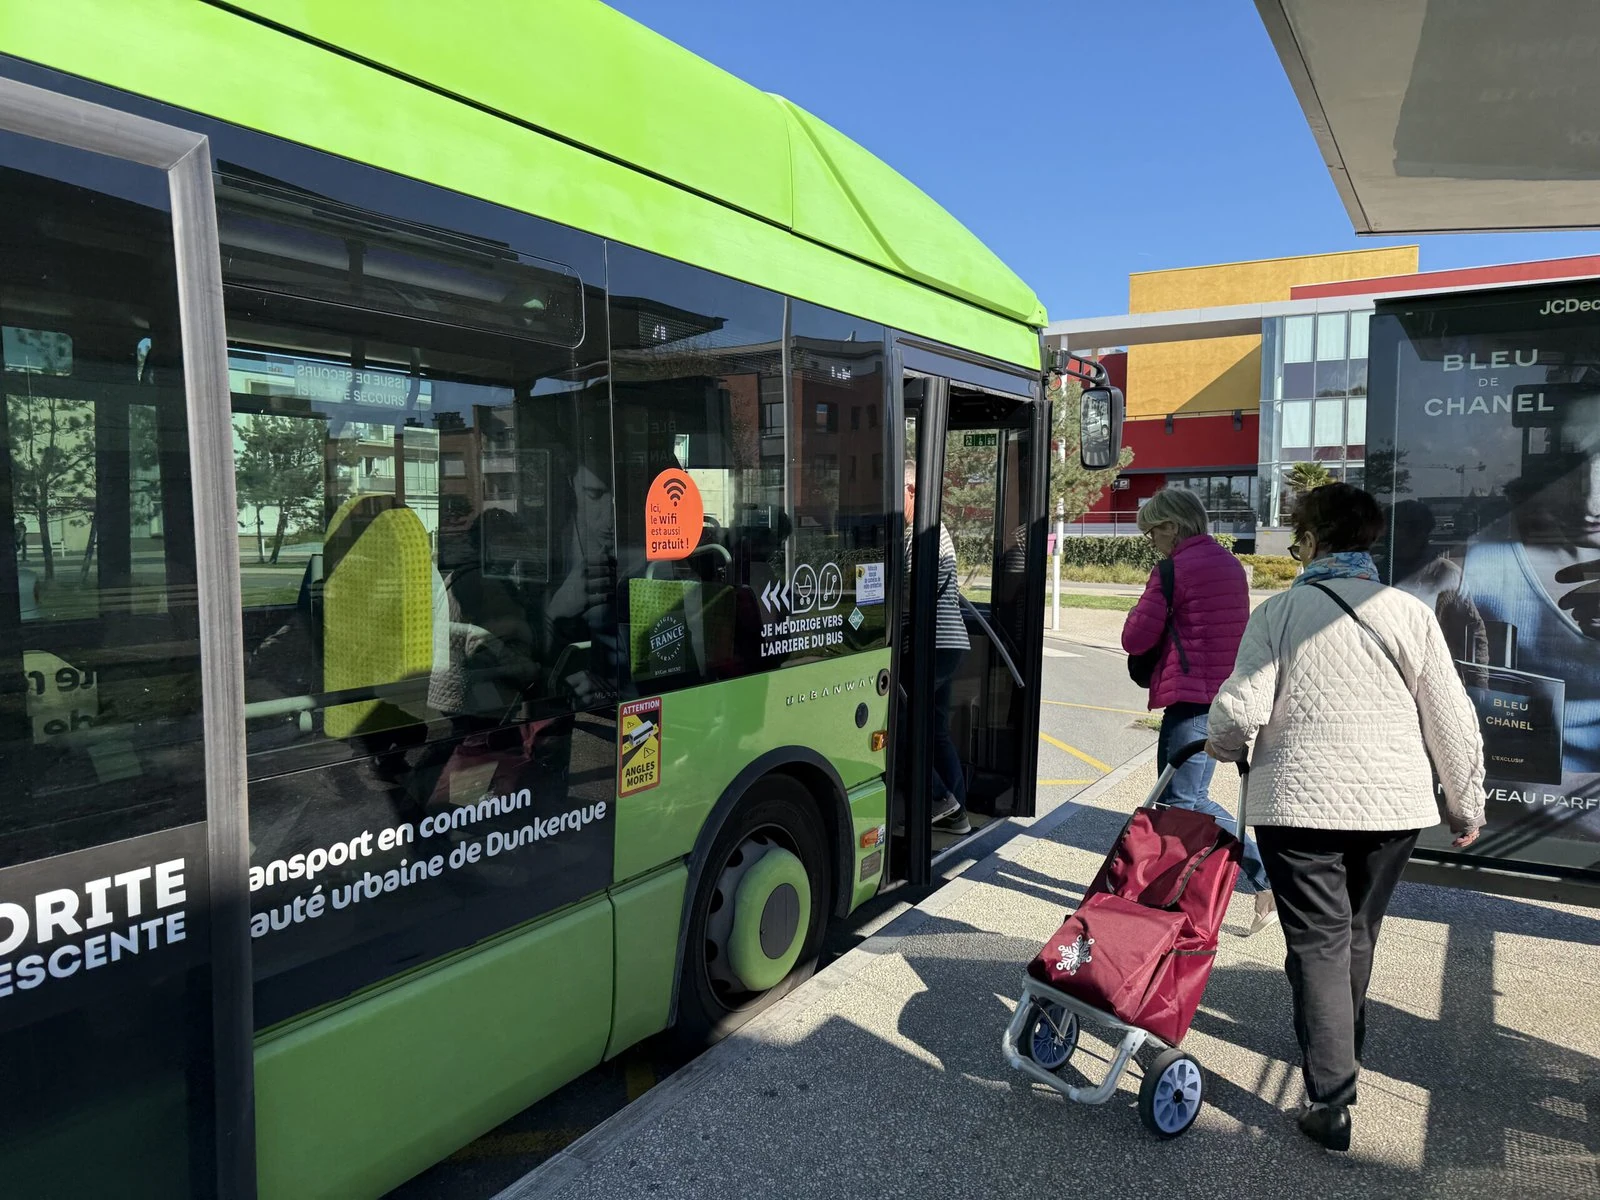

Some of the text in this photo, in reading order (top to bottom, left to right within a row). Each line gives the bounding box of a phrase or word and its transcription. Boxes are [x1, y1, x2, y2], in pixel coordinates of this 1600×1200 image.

[1540, 298, 1600, 315] JCDec
[1443, 349, 1538, 372] BLEU
[1478, 377, 1499, 387] DE
[353, 390, 405, 407] SECOURS
[1424, 393, 1554, 416] CHANEL
[650, 503, 661, 513] Ici,
[650, 513, 677, 525] le wifi
[651, 526, 680, 536] est aussi
[651, 538, 684, 553] gratuit
[761, 614, 843, 637] JE ME DIRIGE VERS
[650, 625, 685, 650] FRANCE
[761, 631, 844, 657] L'ARRIERE DU BUS
[786, 675, 875, 706] URBANWAY
[622, 699, 660, 716] ATTENTION
[1493, 698, 1529, 711] BLEU
[1485, 716, 1534, 731] CHANEL
[1491, 755, 1525, 764] L'EXCLUSIF
[625, 761, 655, 778] ANGLES
[626, 771, 654, 788] MORTS
[1543, 794, 1600, 810] PARF
[248, 788, 531, 892] ansport en commun
[250, 800, 607, 938] auté urbaine de Dunkerque
